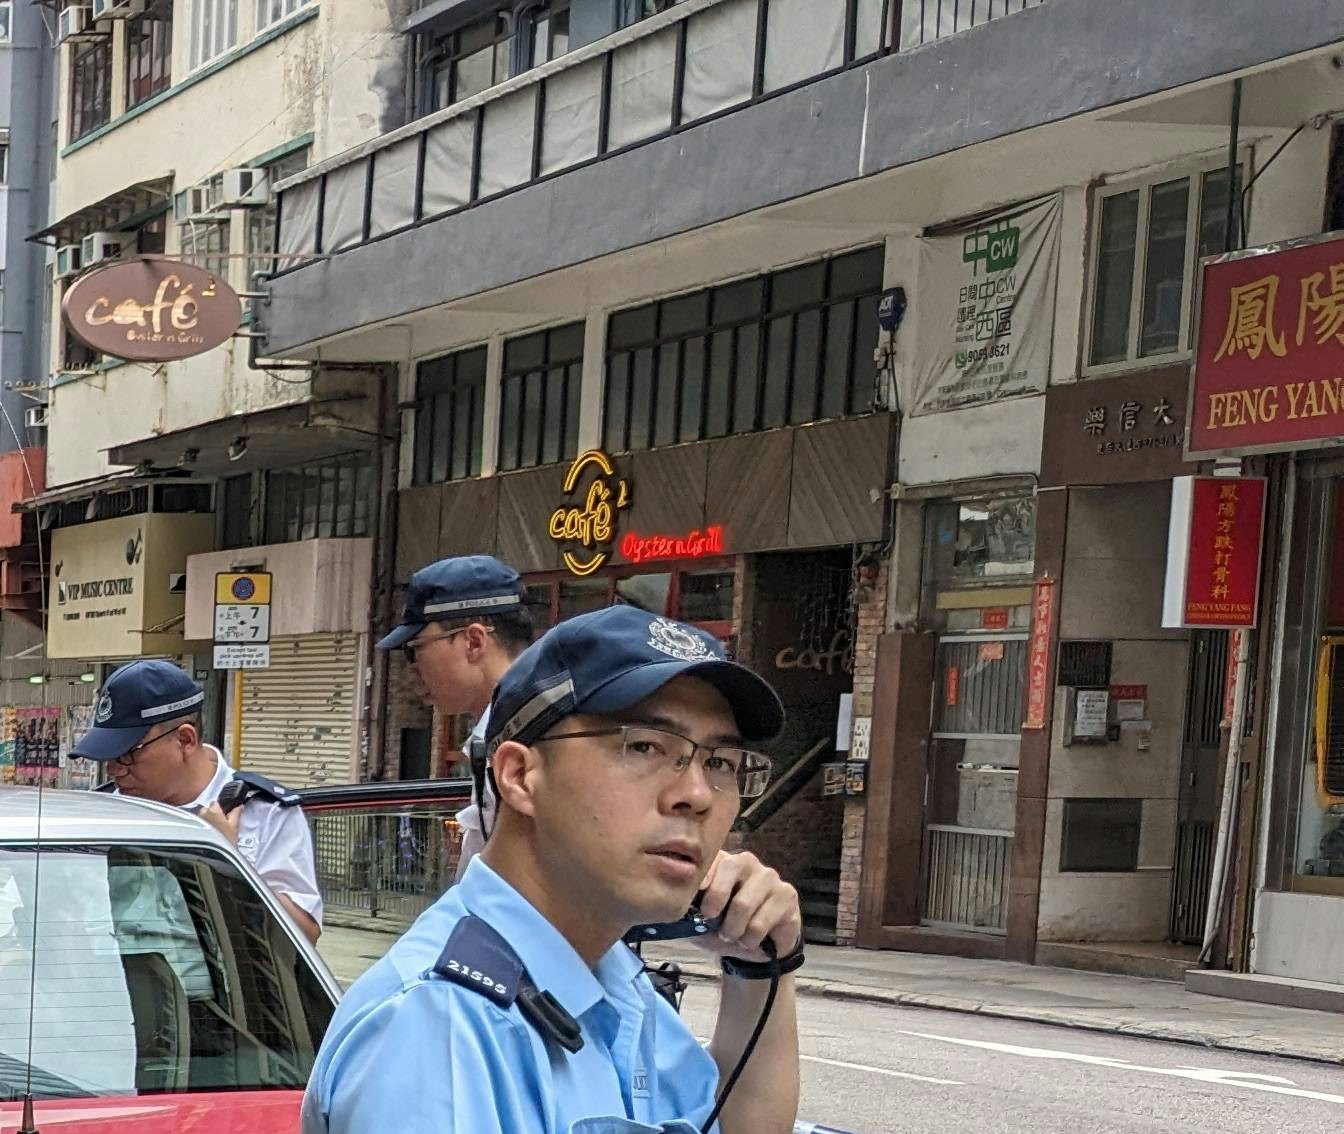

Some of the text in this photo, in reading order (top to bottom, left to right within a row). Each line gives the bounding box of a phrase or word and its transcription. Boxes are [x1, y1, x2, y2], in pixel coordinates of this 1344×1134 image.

[990, 236, 1016, 260] CW
[996, 275, 1017, 294] CW
[85, 274, 198, 333] café
[1214, 262, 1344, 363] 鳳陽
[1206, 385, 1279, 430] FENG
[549, 480, 611, 546] café
[622, 532, 674, 564] Oyster
[687, 526, 724, 556] Grill
[67, 577, 134, 600] VIP MUSIC CENTRE
[250, 607, 260, 619] 7
[250, 626, 260, 638] 7
[446, 959, 508, 995] 21595
